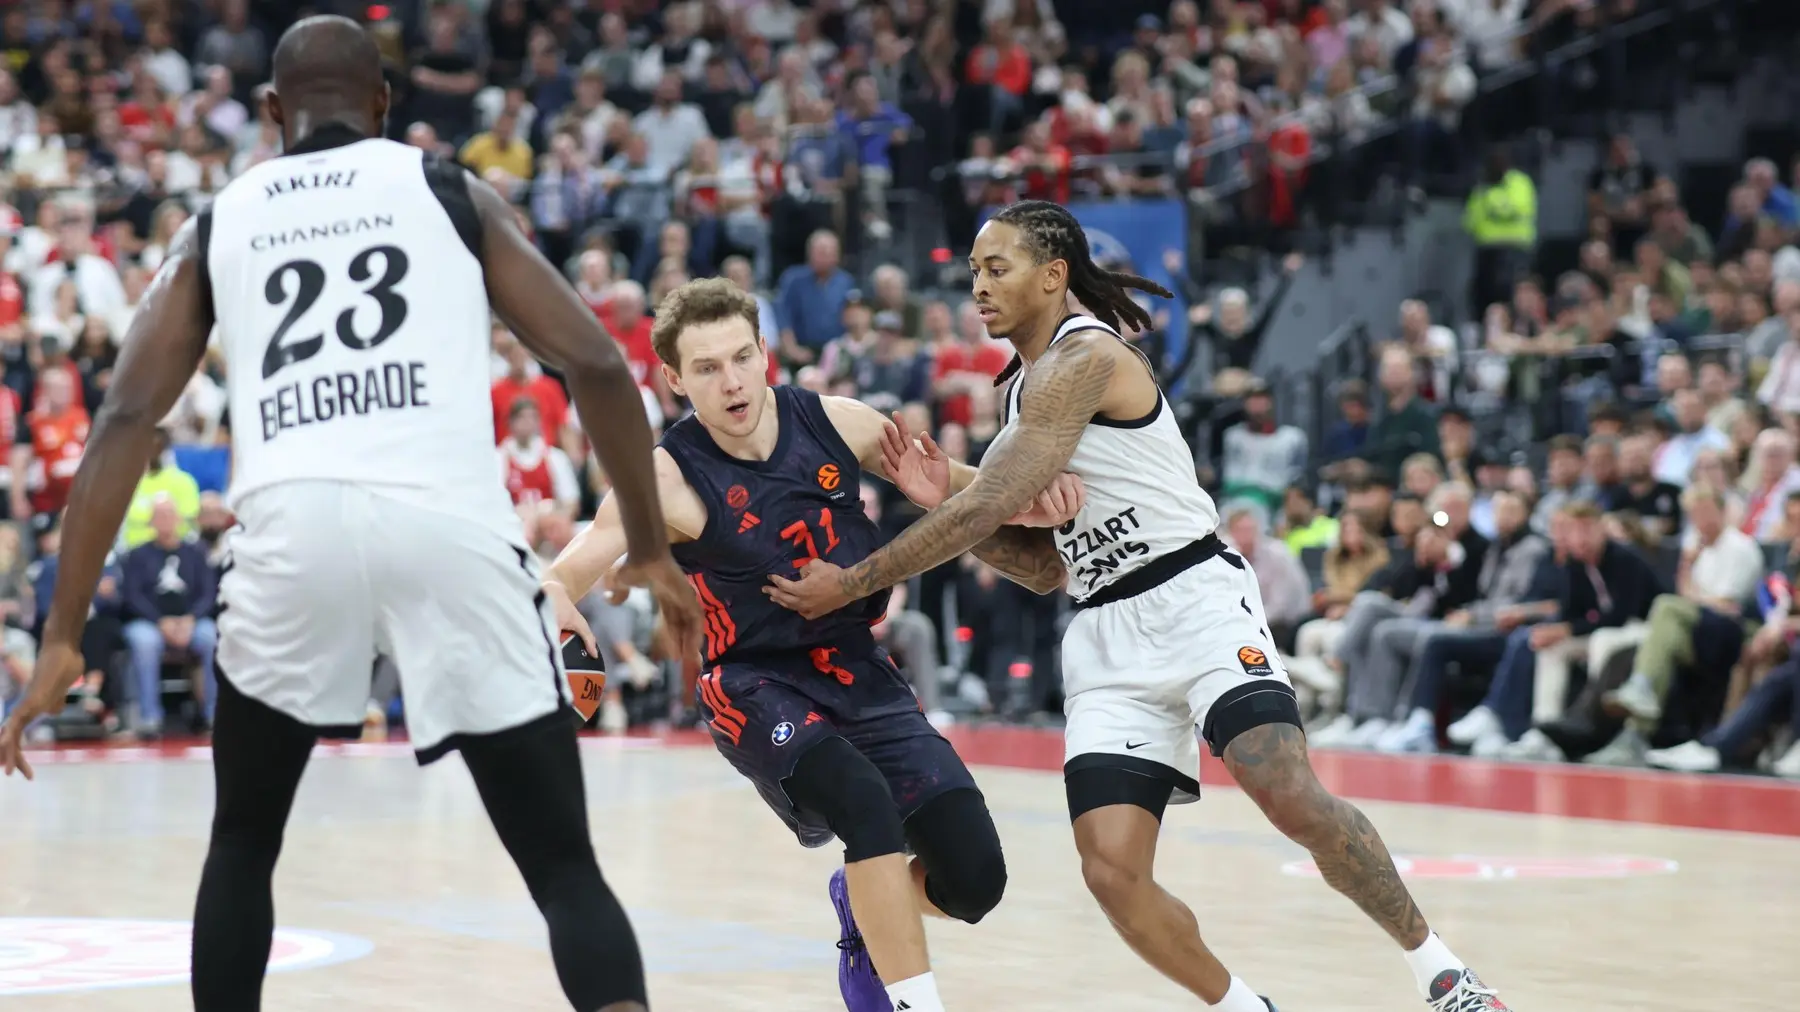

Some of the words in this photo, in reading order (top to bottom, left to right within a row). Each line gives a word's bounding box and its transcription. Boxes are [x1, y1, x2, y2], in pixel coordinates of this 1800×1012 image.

[264, 168, 359, 200] JEKIRI
[250, 213, 394, 252] CHANGAN
[261, 243, 411, 381] 23
[259, 361, 430, 443] BELGRADE
[780, 507, 841, 569] 31
